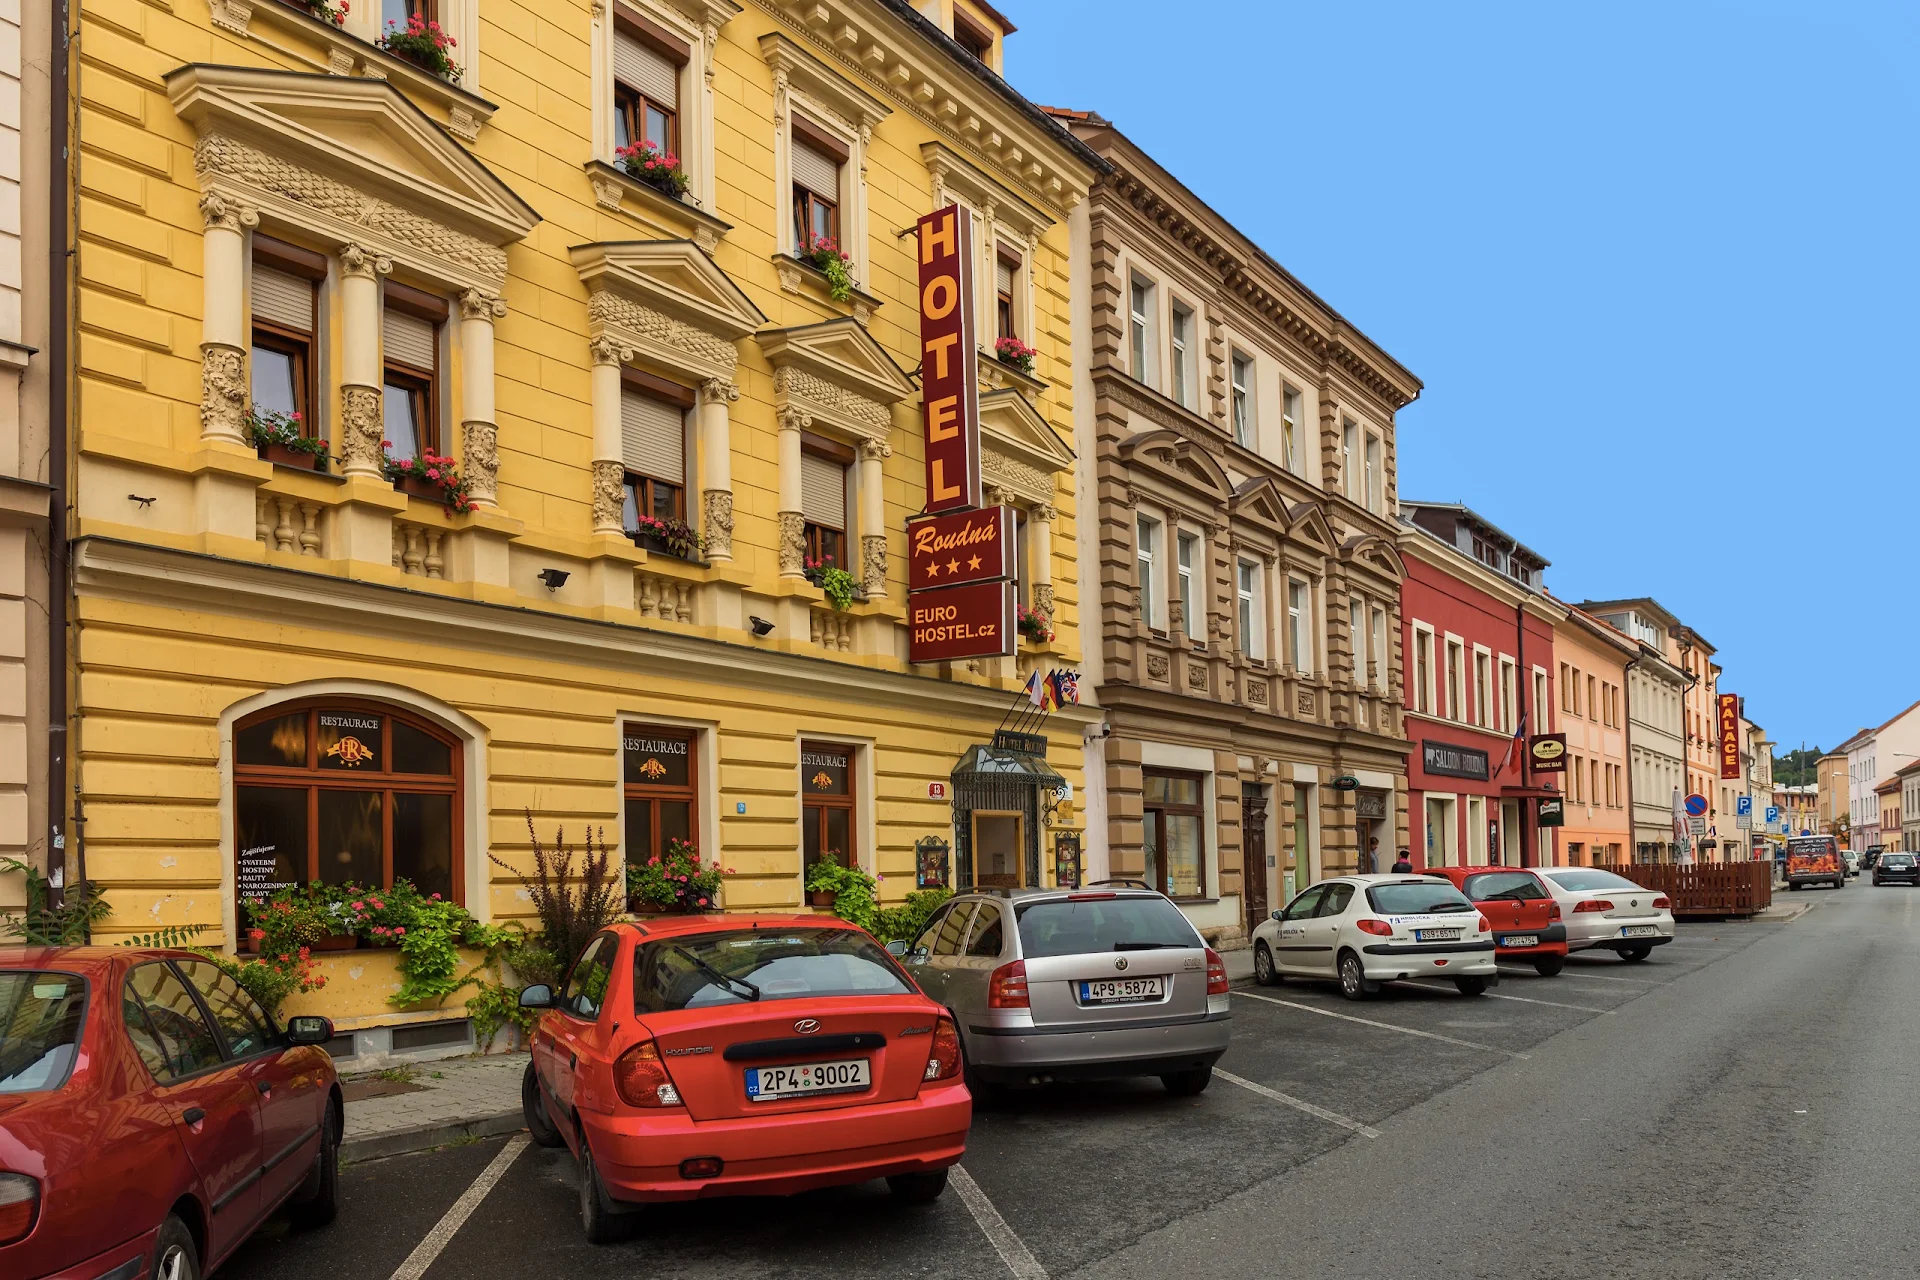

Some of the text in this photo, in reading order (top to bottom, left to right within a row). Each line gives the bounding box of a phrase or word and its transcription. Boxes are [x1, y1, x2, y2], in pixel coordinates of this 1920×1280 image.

[921, 213, 961, 502] HOTEL
[915, 516, 996, 557] Roudná
[915, 606, 957, 623] EURO
[915, 624, 995, 643] HOSTEL.cz
[320, 716, 378, 729] RESTAURACE
[1722, 696, 1736, 765] PALACE
[1435, 749, 1461, 770] SALOON
[242, 858, 276, 866] SVATEBNÍ
[1422, 929, 1456, 939] 6S9 6511
[1092, 980, 1156, 997] 4P9 5872
[665, 1047, 713, 1056] HYUNDAI
[763, 1063, 861, 1091] 2P4 9002
